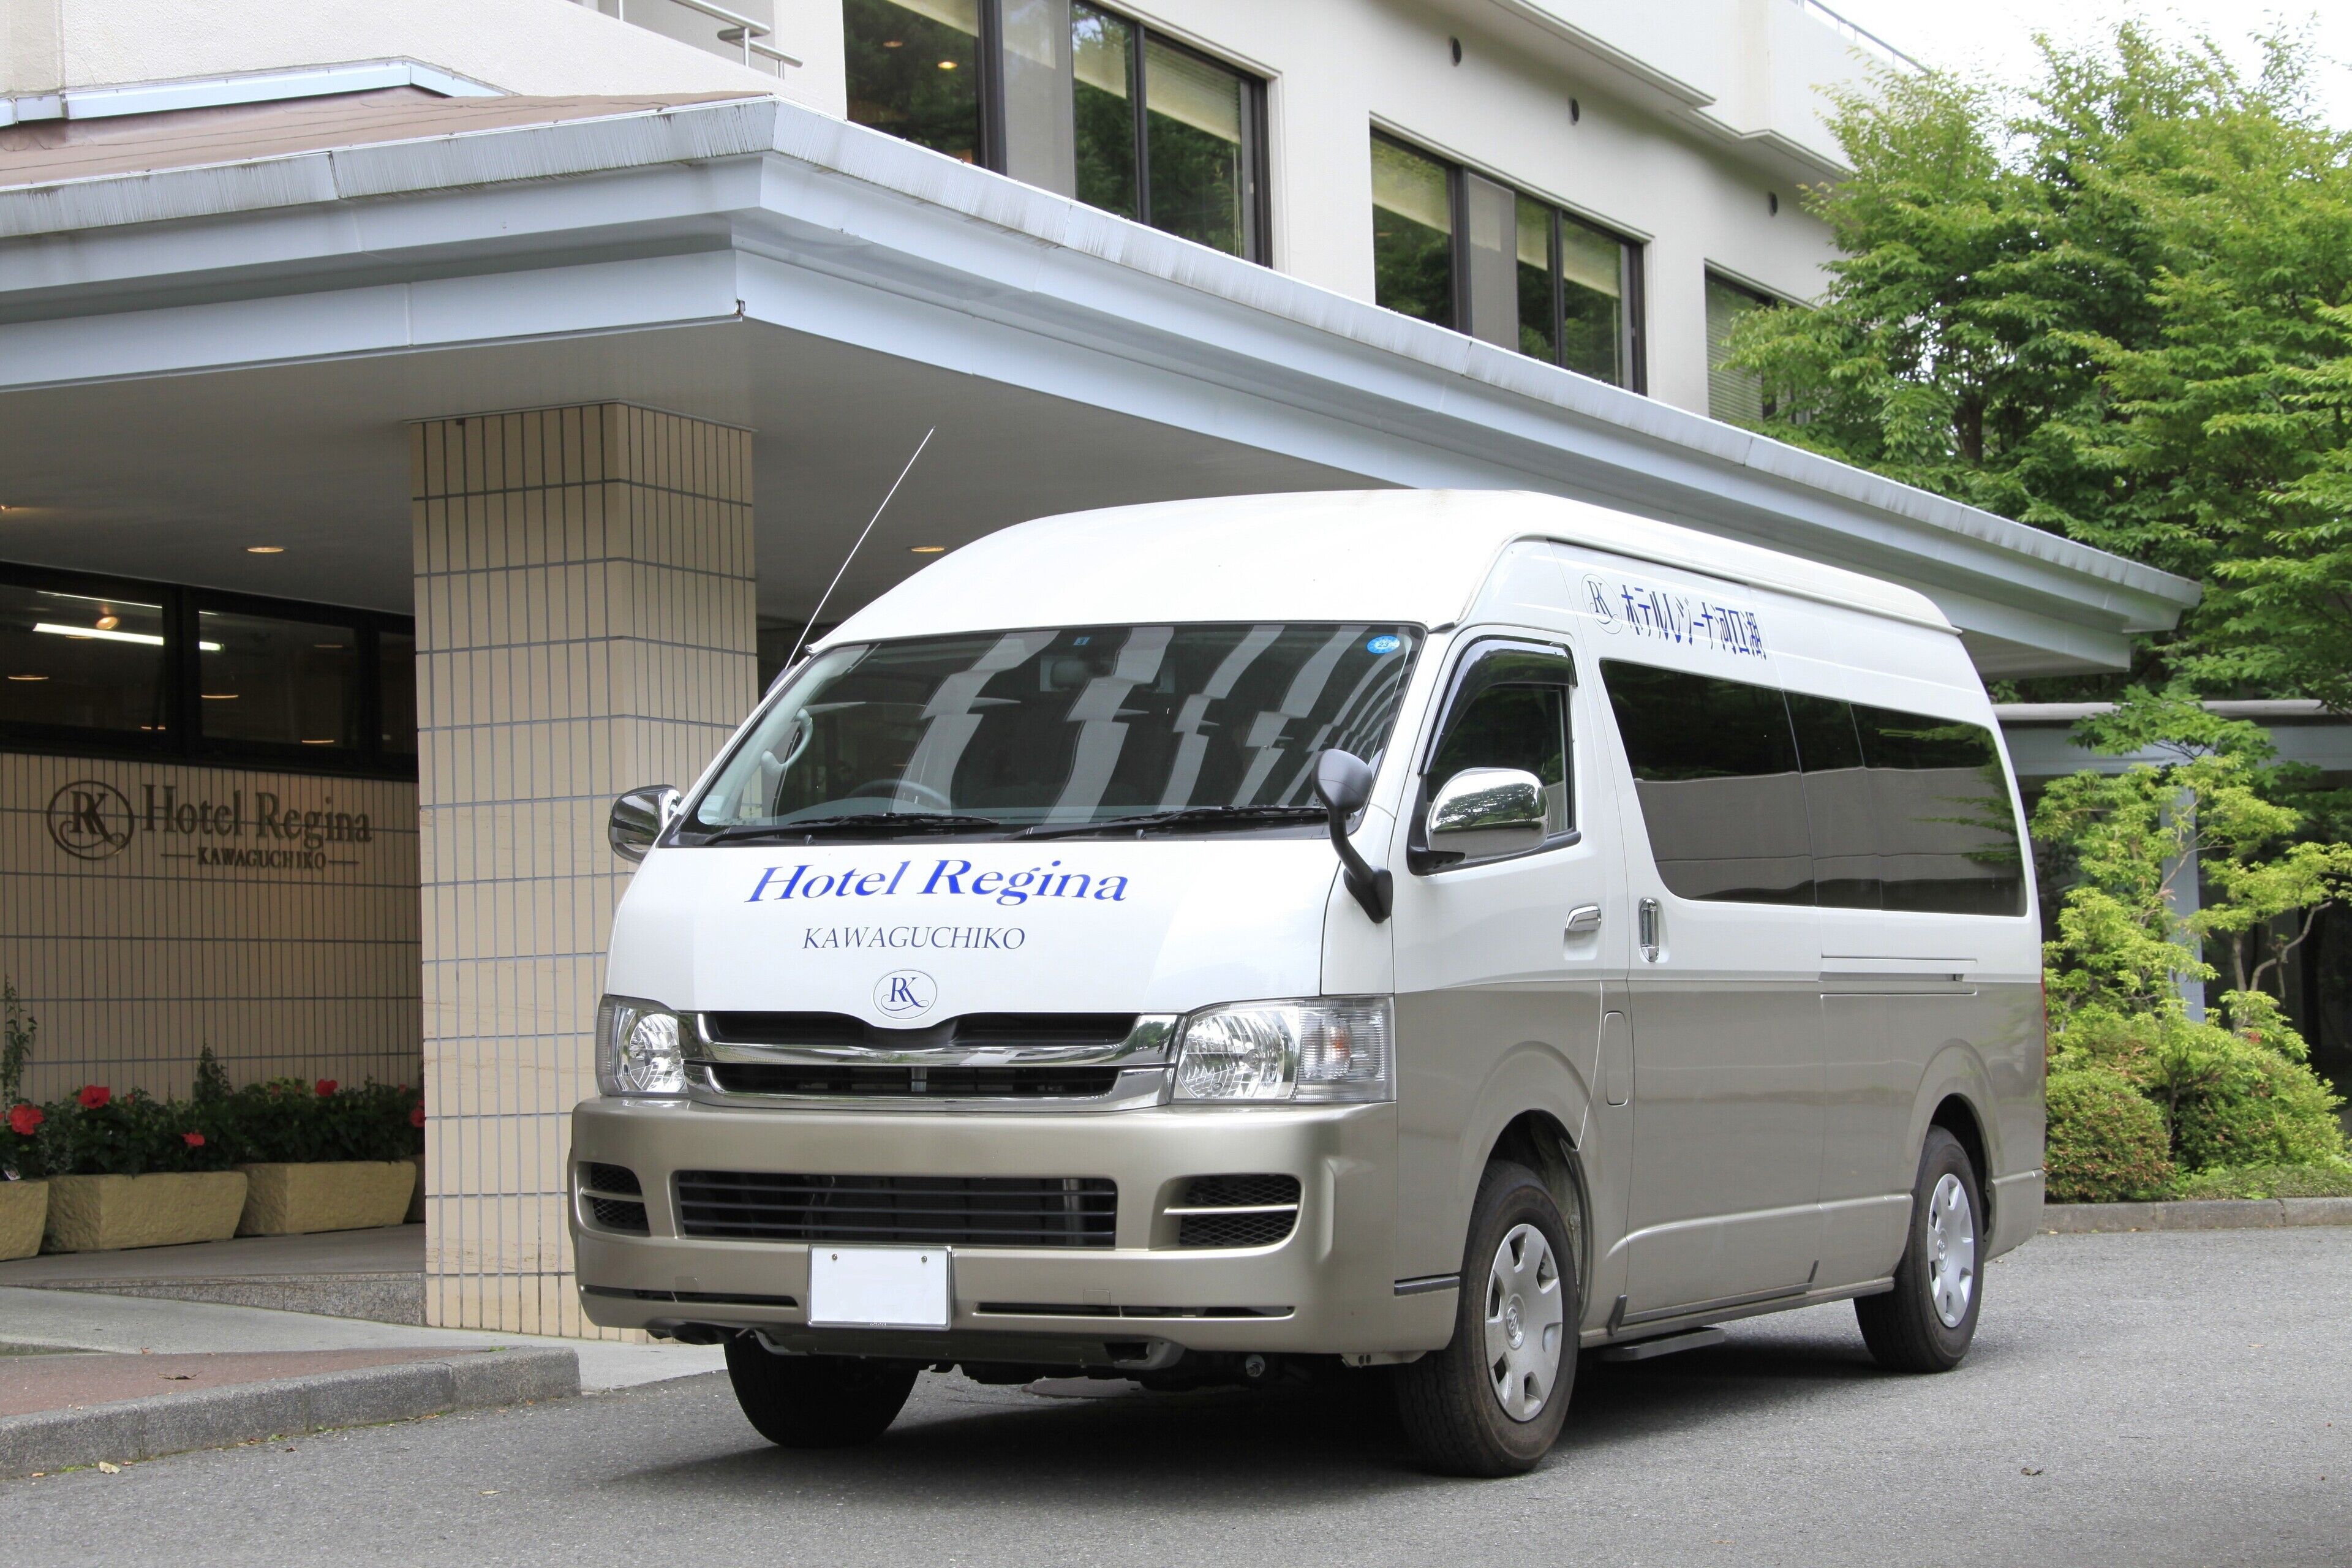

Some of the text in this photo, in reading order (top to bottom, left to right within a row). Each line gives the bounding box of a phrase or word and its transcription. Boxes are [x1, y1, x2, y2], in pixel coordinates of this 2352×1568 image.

[1621, 584, 1766, 660] ホテルレジーナ河口湖
[142, 784, 372, 850] Hotel Regina
[197, 846, 326, 870] KAWAGUCHIKO
[743, 859, 1128, 906] Hotel Regina
[801, 925, 1025, 950] KAWAGUCHIKO
